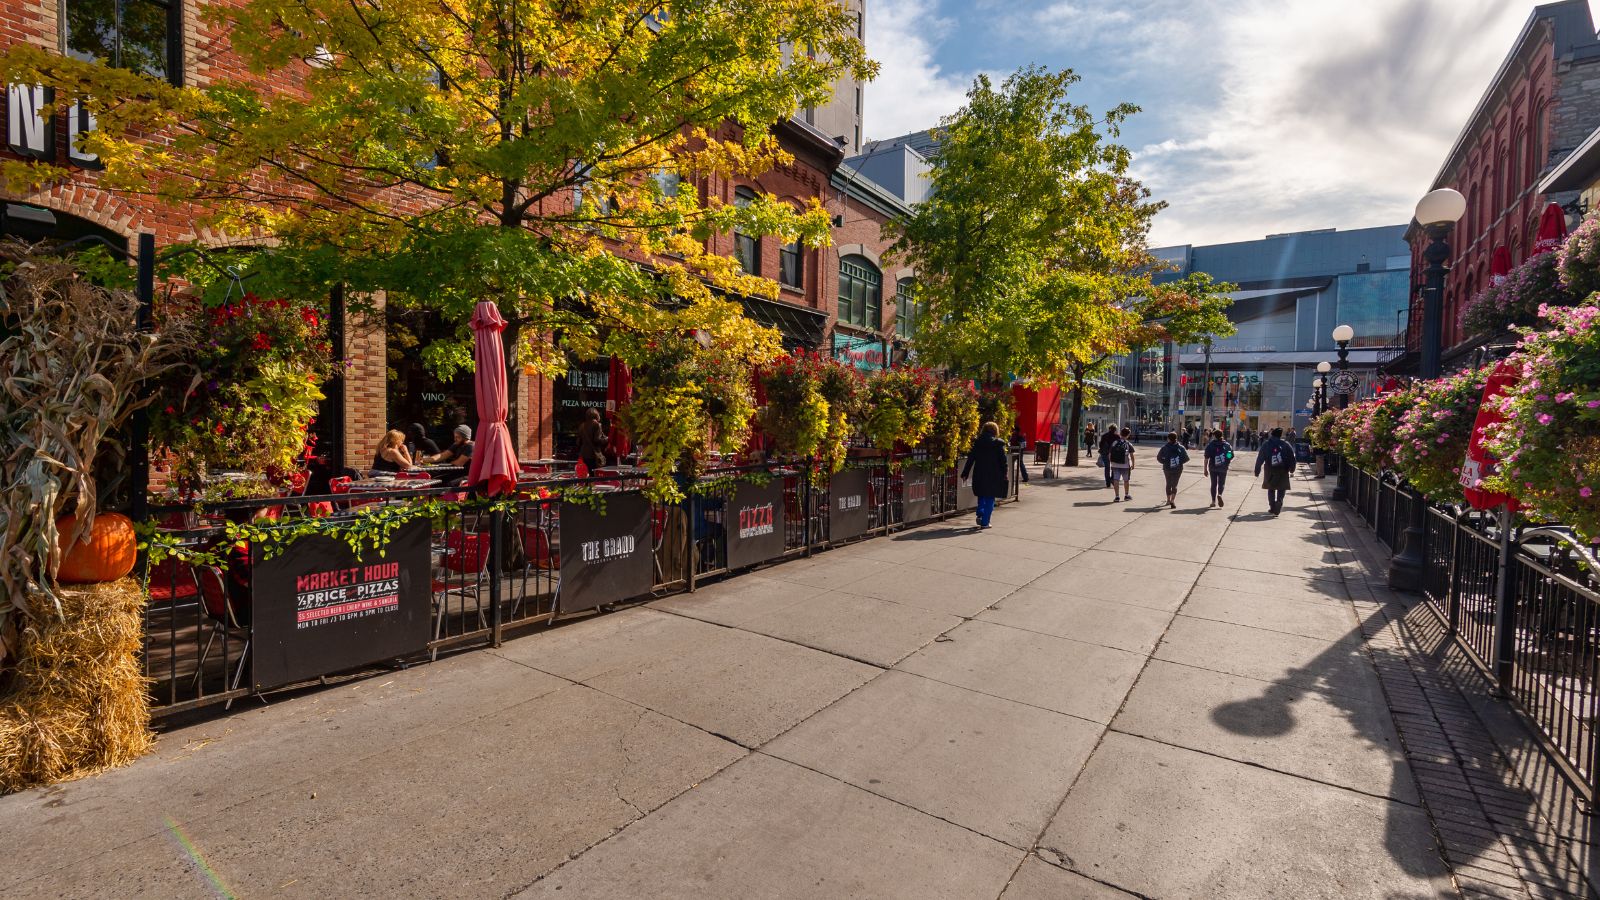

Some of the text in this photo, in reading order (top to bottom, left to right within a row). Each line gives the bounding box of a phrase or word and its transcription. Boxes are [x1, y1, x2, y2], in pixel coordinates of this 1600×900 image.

[421, 392, 446, 401] VINO
[740, 507, 773, 529] PIZZA
[581, 535, 635, 561] THE GRAND
[297, 562, 399, 592] MARKET HOUR
[358, 580, 399, 595] PIZZAS
[298, 622, 309, 630] MON
